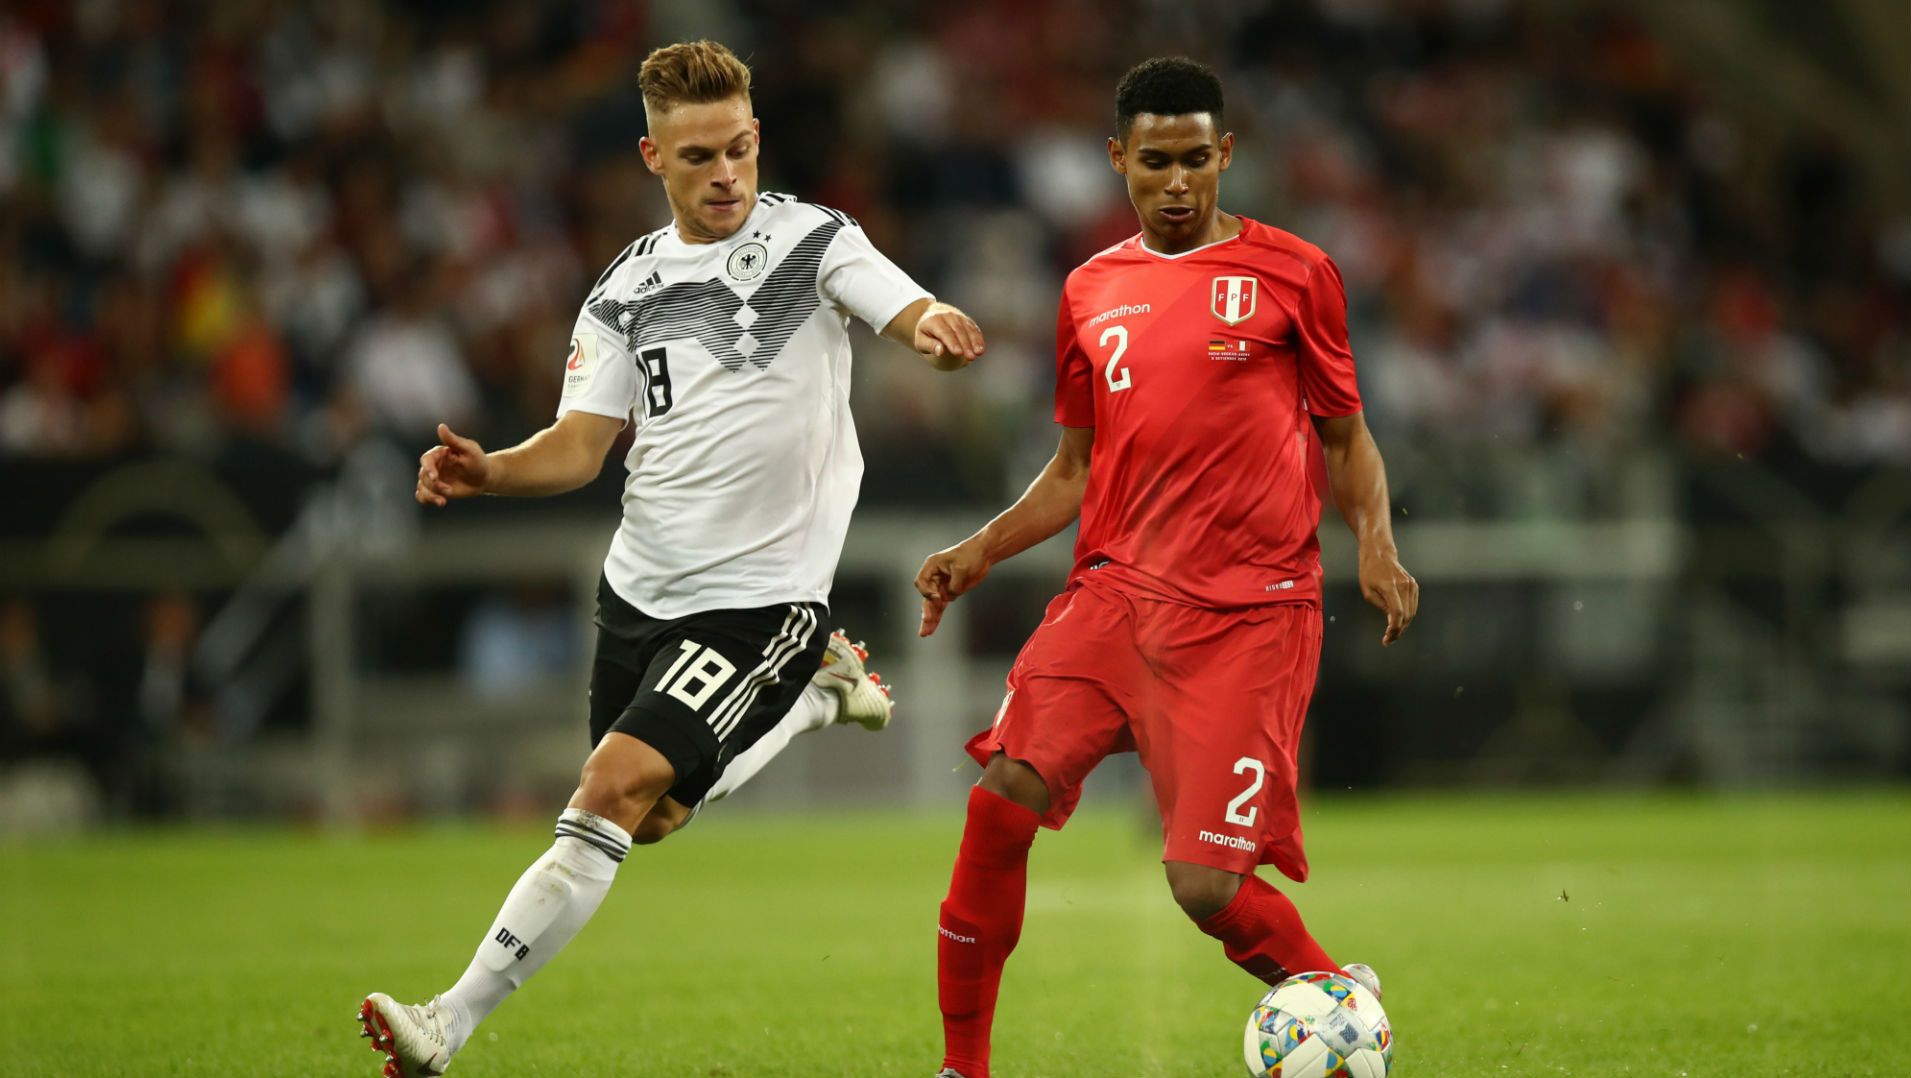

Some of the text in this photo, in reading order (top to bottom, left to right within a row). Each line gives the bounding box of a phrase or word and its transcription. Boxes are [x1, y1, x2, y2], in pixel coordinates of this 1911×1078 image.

[1088, 303, 1151, 328] marathon
[1099, 324, 1132, 393] 2
[653, 638, 738, 712] 18
[1225, 756, 1265, 828] 2
[1198, 830, 1256, 853] marathon
[495, 927, 530, 961] DFB
